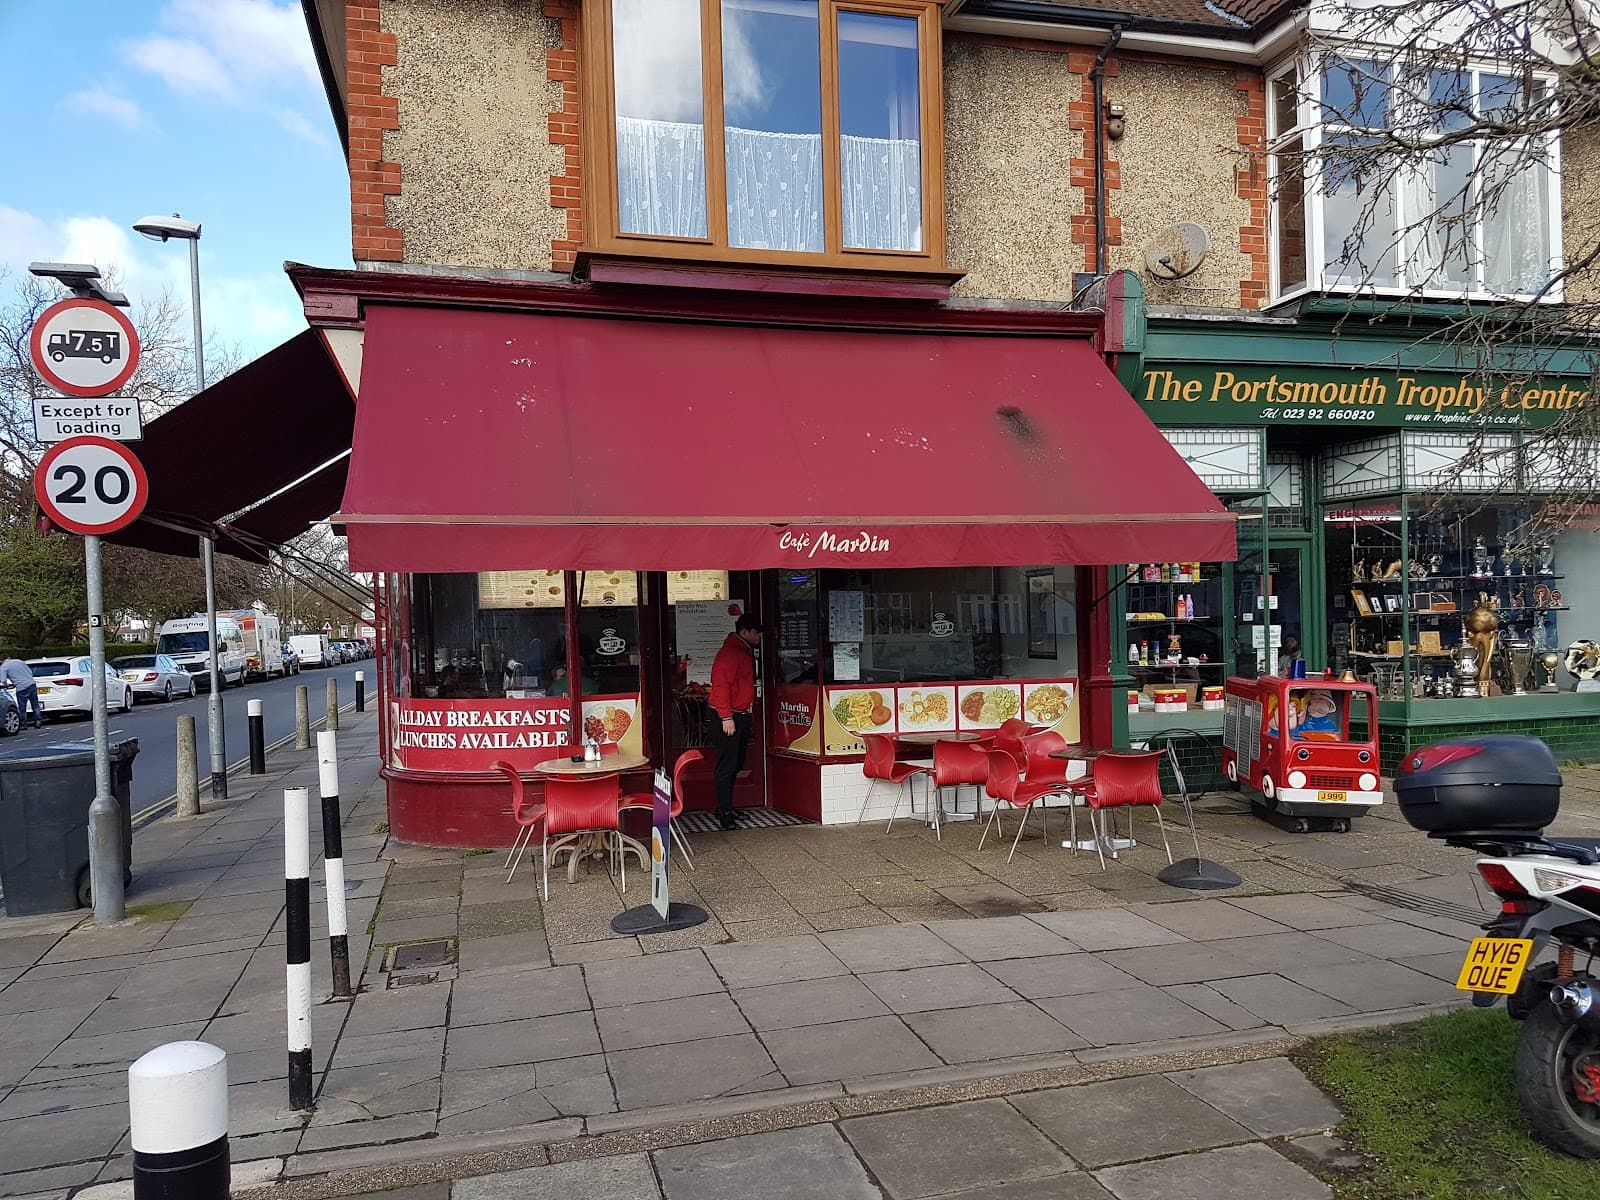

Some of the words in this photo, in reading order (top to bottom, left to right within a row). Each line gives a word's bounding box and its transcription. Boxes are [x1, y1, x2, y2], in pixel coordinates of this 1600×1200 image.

[1142, 371, 1203, 402] The
[1207, 371, 1387, 407] Portsmouth
[1395, 376, 1486, 414] Trophy
[41, 404, 101, 418] Except
[107, 404, 132, 417] for
[1283, 408, 1304, 419] 023
[1307, 408, 1323, 419] 92
[1327, 409, 1375, 421] 660820
[56, 421, 121, 435] loading
[53, 464, 130, 505] 20
[807, 530, 890, 558] Mardin
[91, 616, 99, 627] 9
[780, 701, 810, 713] Mardin
[399, 710, 443, 727] ALLDAY
[446, 709, 571, 728] BREAKFASTS
[778, 710, 813, 727] Cafe
[399, 732, 457, 749] LUNCHES
[459, 731, 569, 749] AVAILABLE
[1471, 941, 1524, 965] HY16
[1467, 965, 1513, 989] OUE
